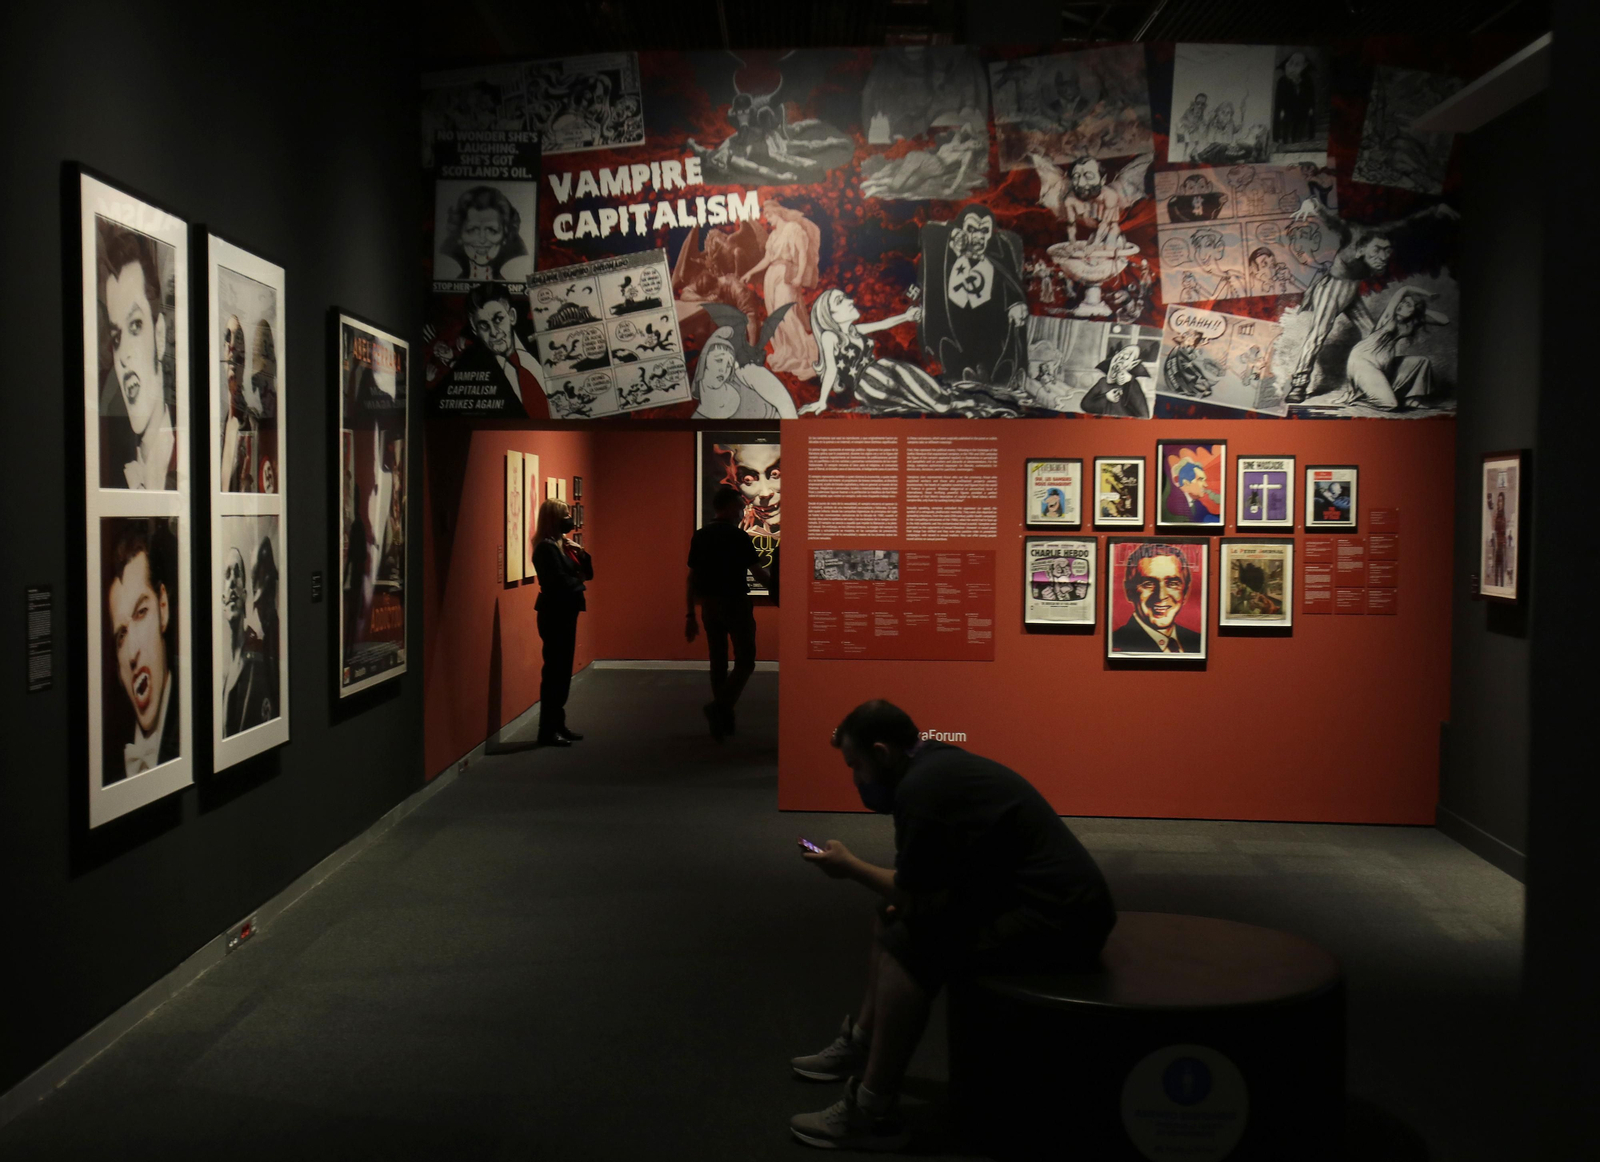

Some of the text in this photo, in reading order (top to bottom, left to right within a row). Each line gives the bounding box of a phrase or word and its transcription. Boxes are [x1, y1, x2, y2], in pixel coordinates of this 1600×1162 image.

[437, 130, 538, 143] NO WONDER SHE'S
[457, 142, 519, 154] LAUGHING.
[460, 154, 515, 166] SHE'S GOT
[442, 166, 532, 178] SCOTLAND'S OIL.
[548, 156, 703, 204] VAMPIRE
[553, 191, 760, 241] CAPITALISM
[433, 281, 452, 291] STOP
[453, 371, 491, 381] VAMPIRE
[446, 385, 498, 395] CAPITALISM
[439, 399, 505, 409] STRIKES AGAIN!
[1031, 549, 1089, 558] CHARLIE HEBDO
